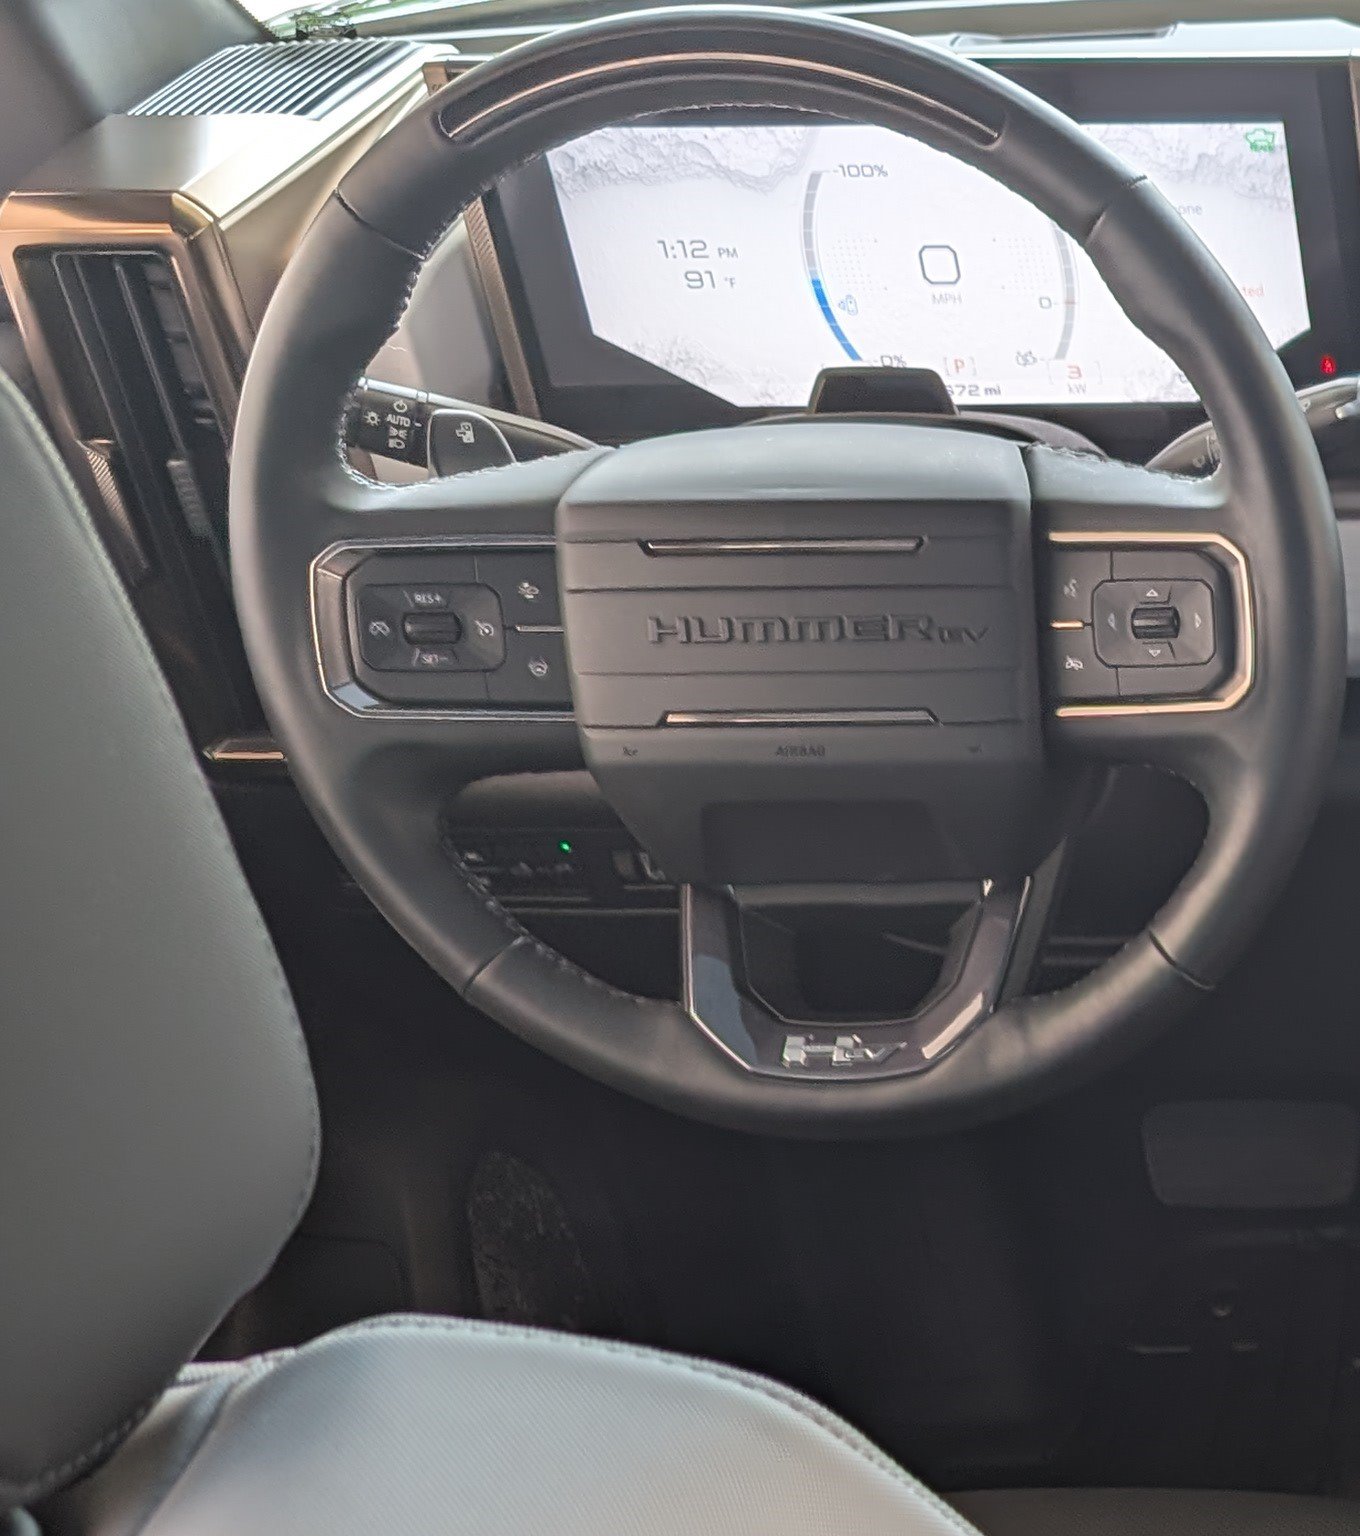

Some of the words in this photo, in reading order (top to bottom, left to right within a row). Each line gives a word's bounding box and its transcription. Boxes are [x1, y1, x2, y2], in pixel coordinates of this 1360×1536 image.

[838, 164, 889, 178] 100%
[656, 239, 710, 259] 1:12
[717, 247, 739, 259] PM
[918, 245, 961, 285] 0
[684, 270, 716, 290] 91
[931, 294, 963, 305] MPH
[1067, 365, 1082, 380] 3
[385, 413, 411, 428] AUTO
[648, 614, 935, 645] HUMMER
